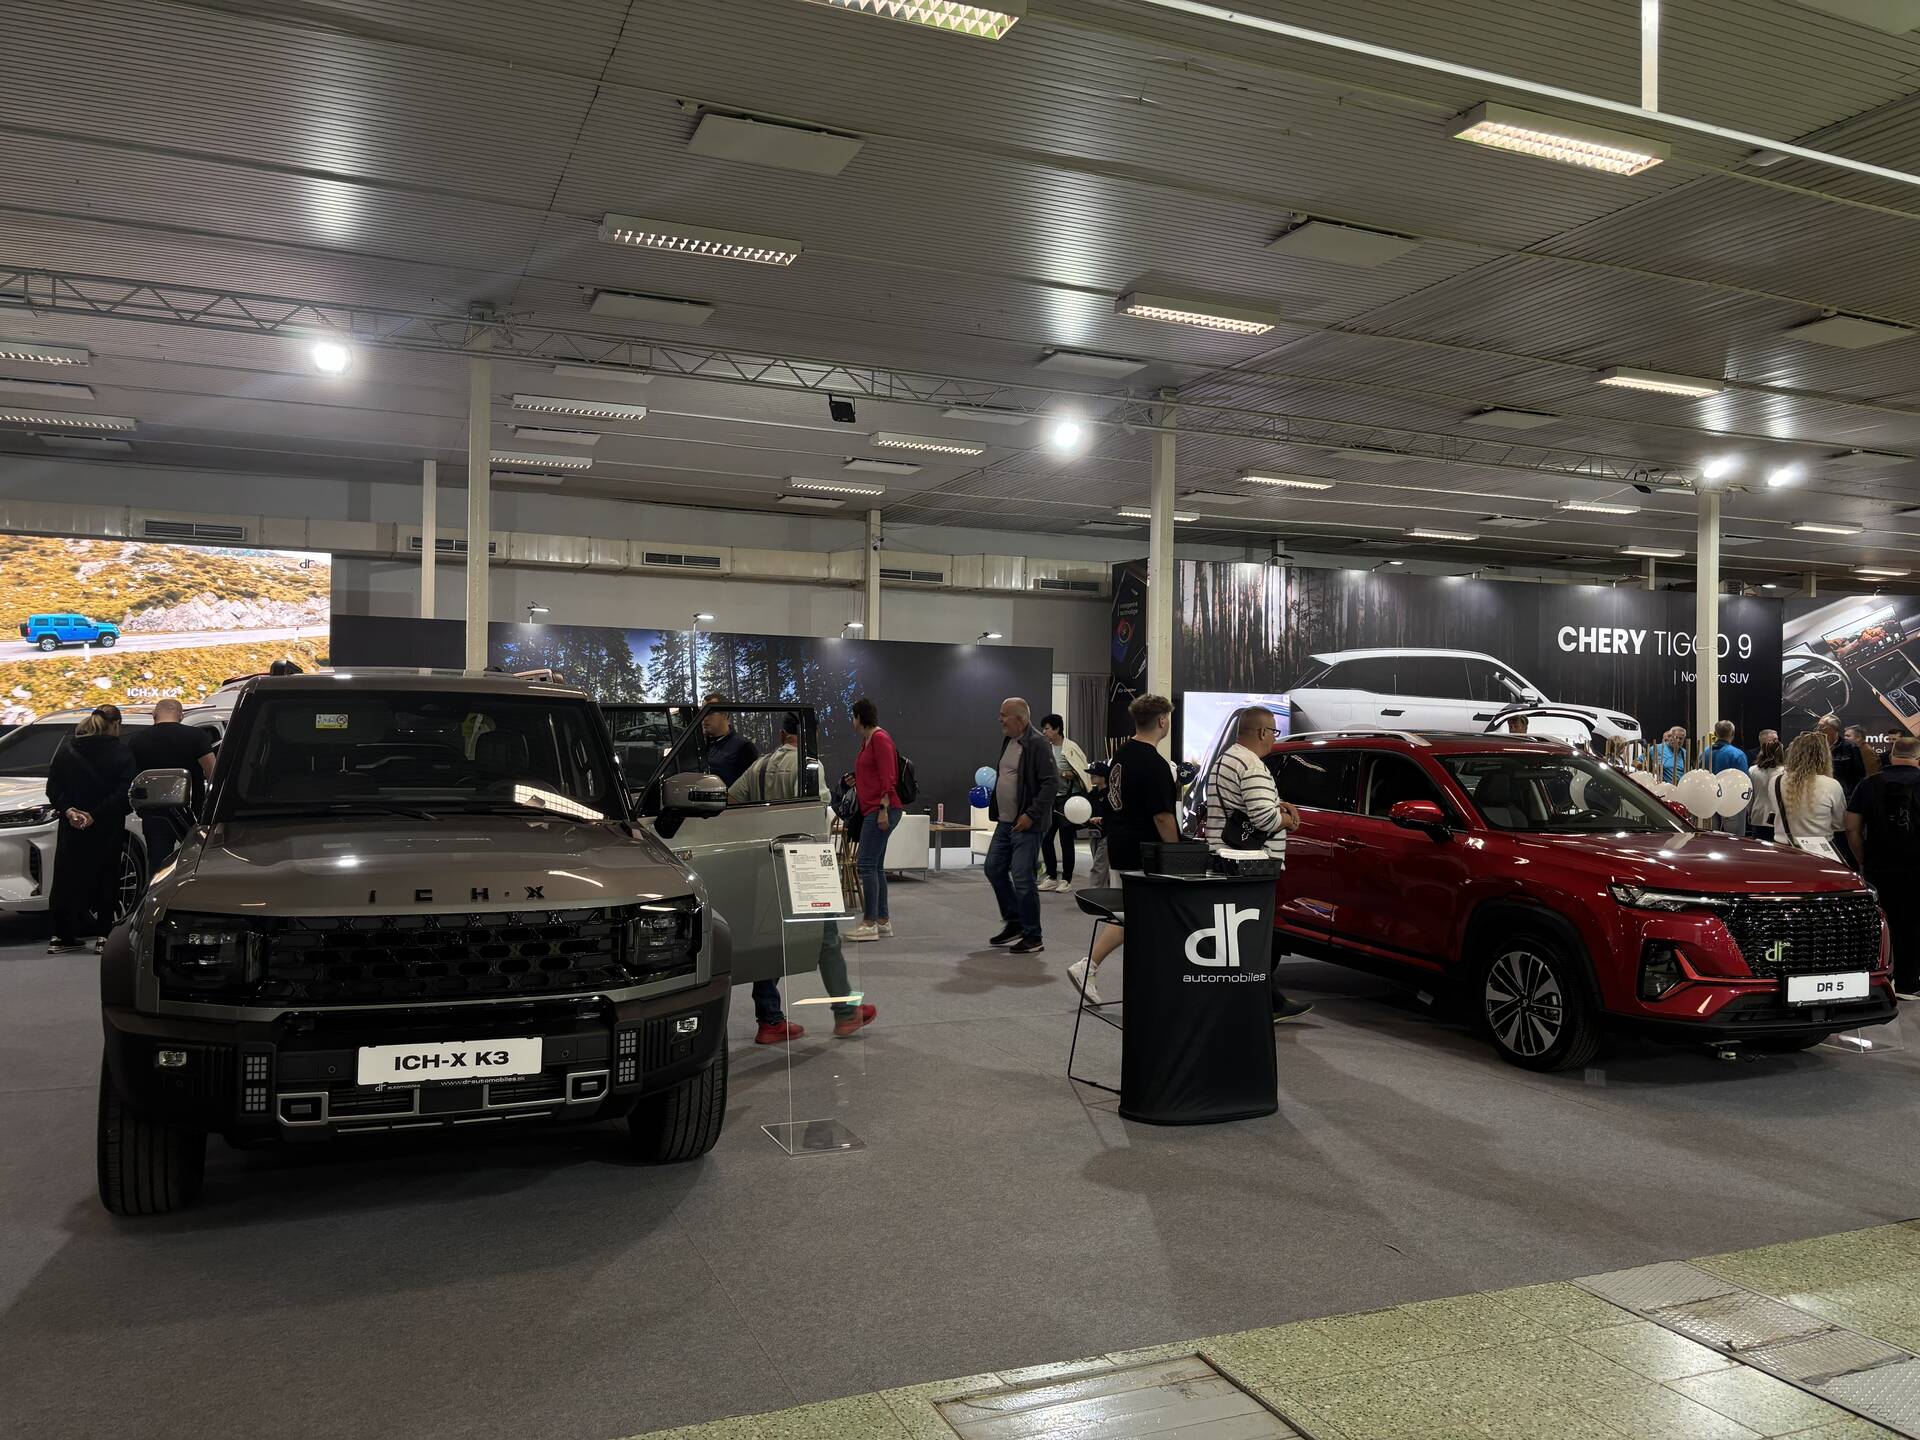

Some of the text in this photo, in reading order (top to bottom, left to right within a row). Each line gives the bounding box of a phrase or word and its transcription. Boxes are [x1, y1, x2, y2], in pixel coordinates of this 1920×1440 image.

[300, 558, 315, 568] dr
[1558, 626, 1752, 659] CHERY TIGO 9
[1729, 672, 1750, 684] SUV
[127, 687, 178, 697] ICH-X K2
[1184, 903, 1260, 967] dr
[1765, 940, 1791, 961] dr
[1182, 973, 1267, 983] automobiles
[1816, 981, 1845, 992] DR 5
[394, 1050, 510, 1071] ICH-X K3
